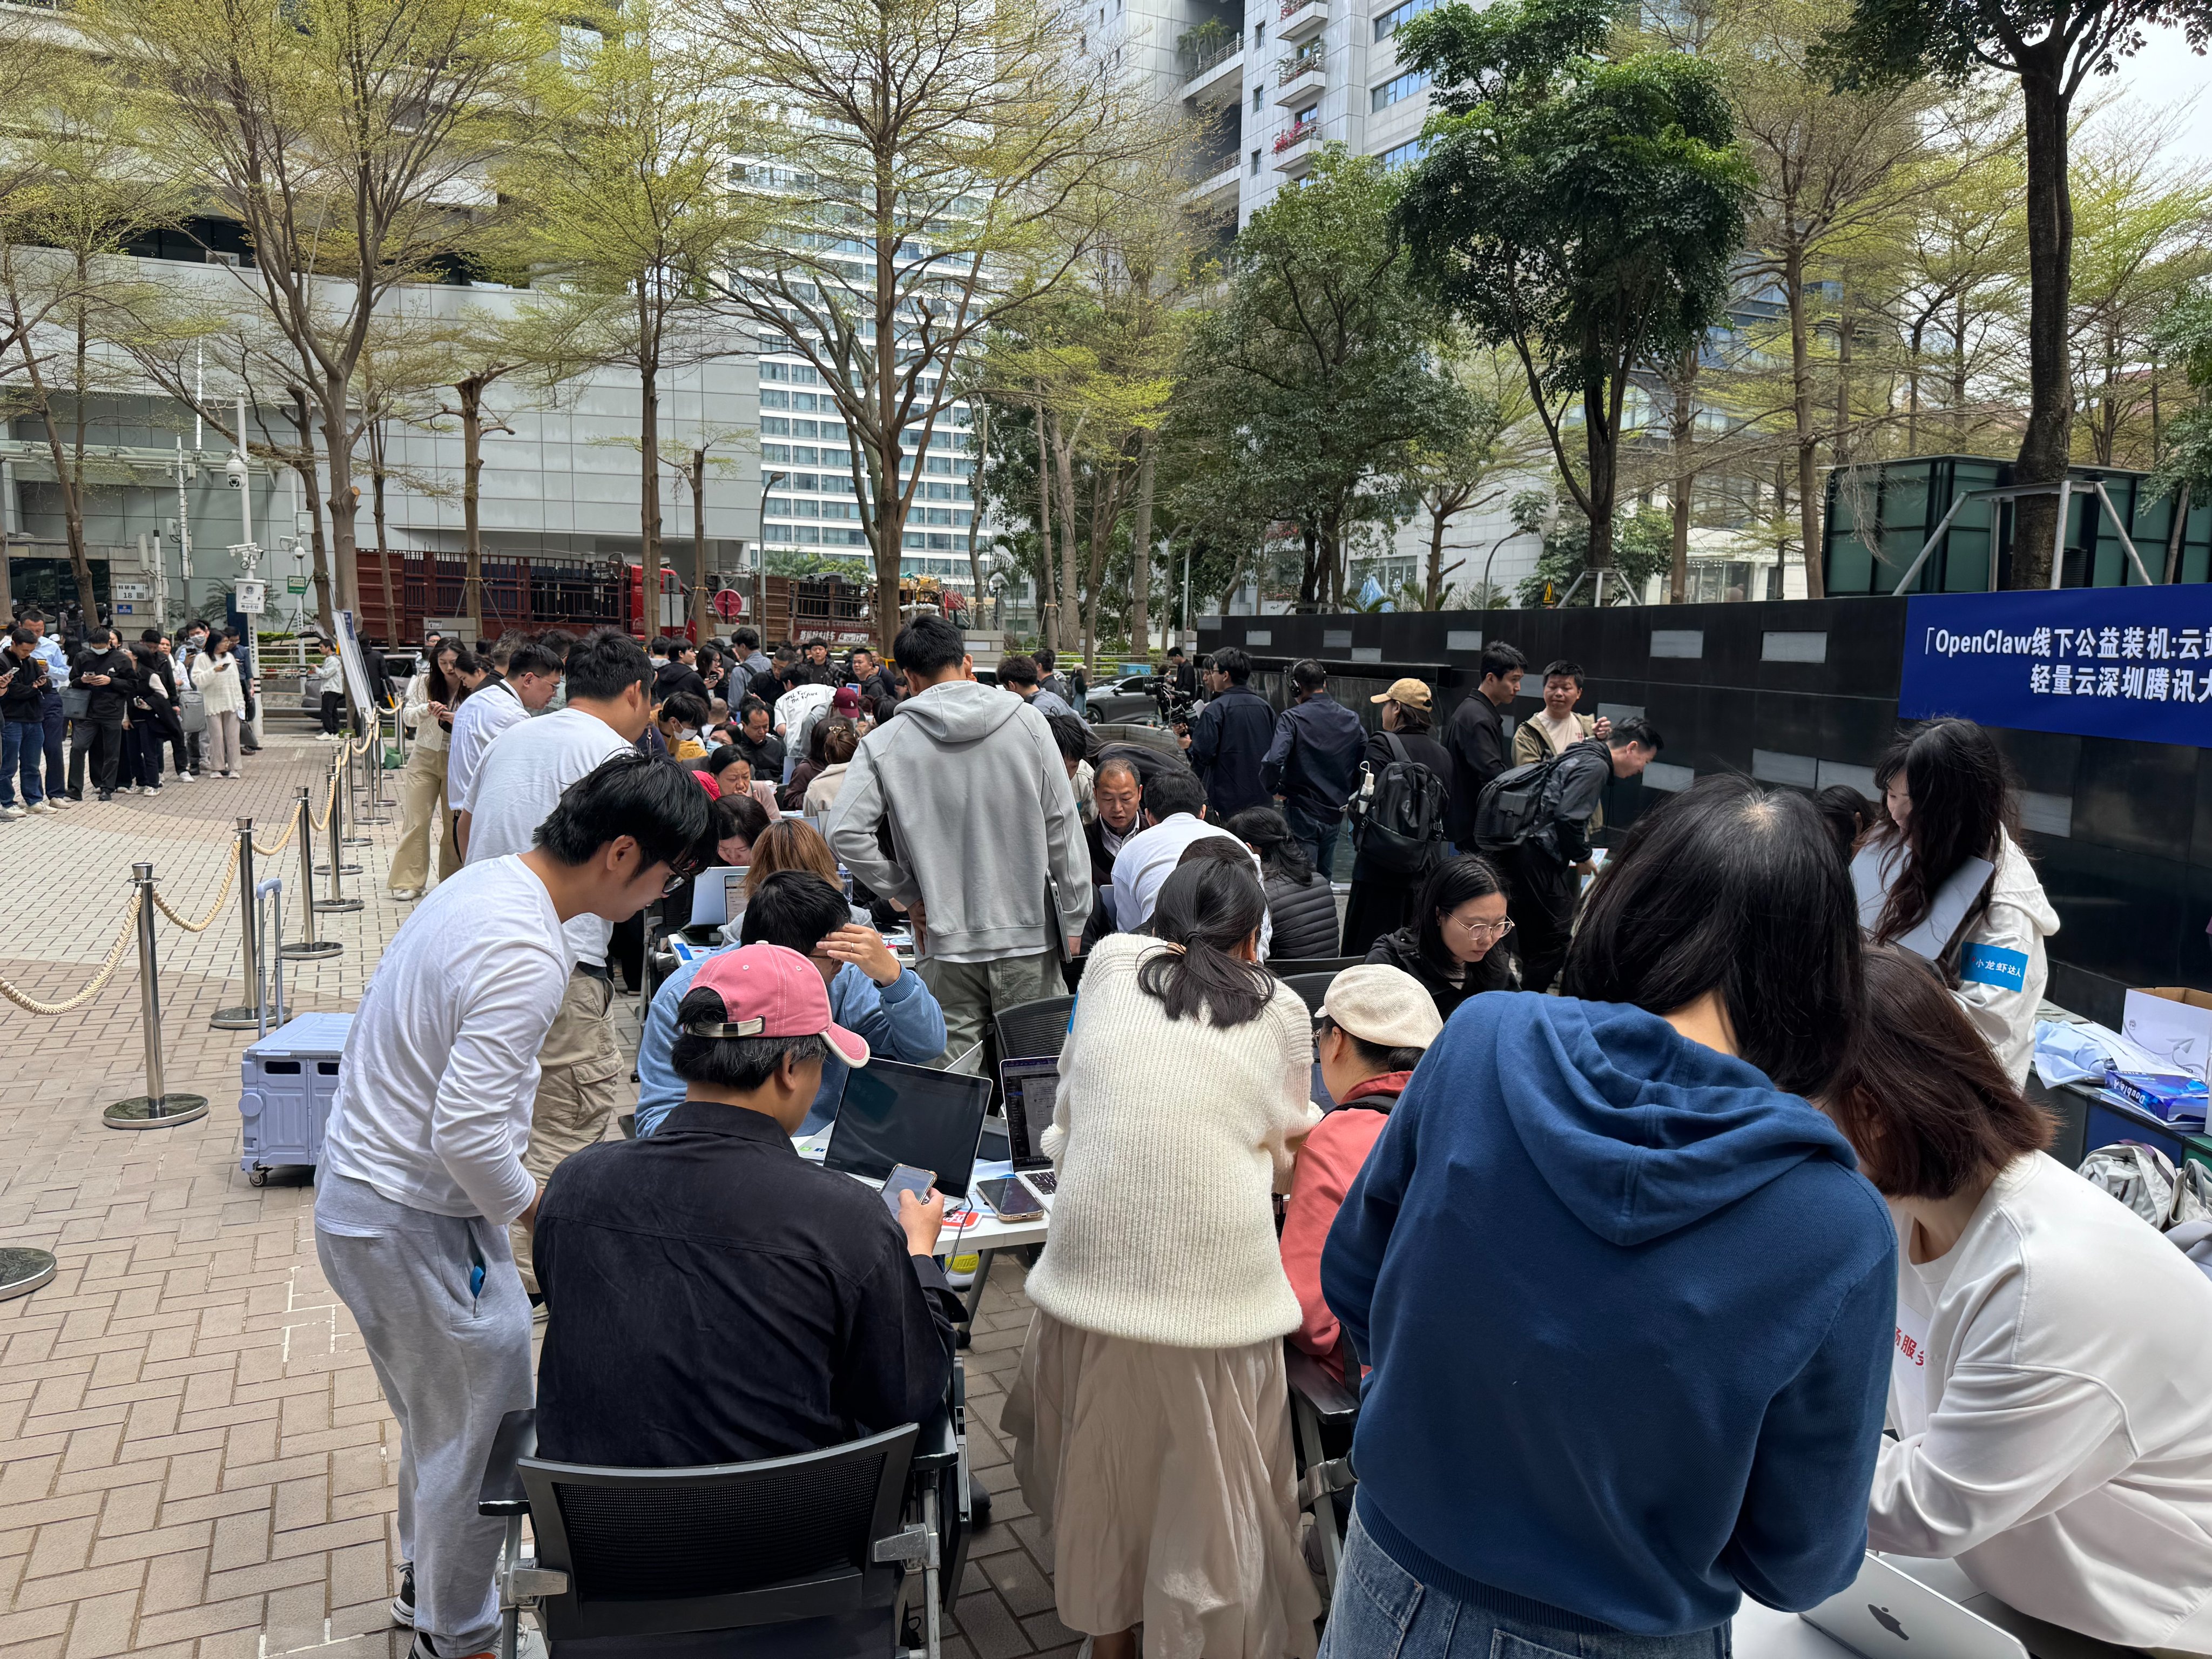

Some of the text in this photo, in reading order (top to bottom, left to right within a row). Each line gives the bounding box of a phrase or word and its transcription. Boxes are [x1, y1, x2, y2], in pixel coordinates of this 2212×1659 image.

[1975, 959, 2021, 977] 小龙虾达人
[2113, 1080, 2146, 1104] Double A
